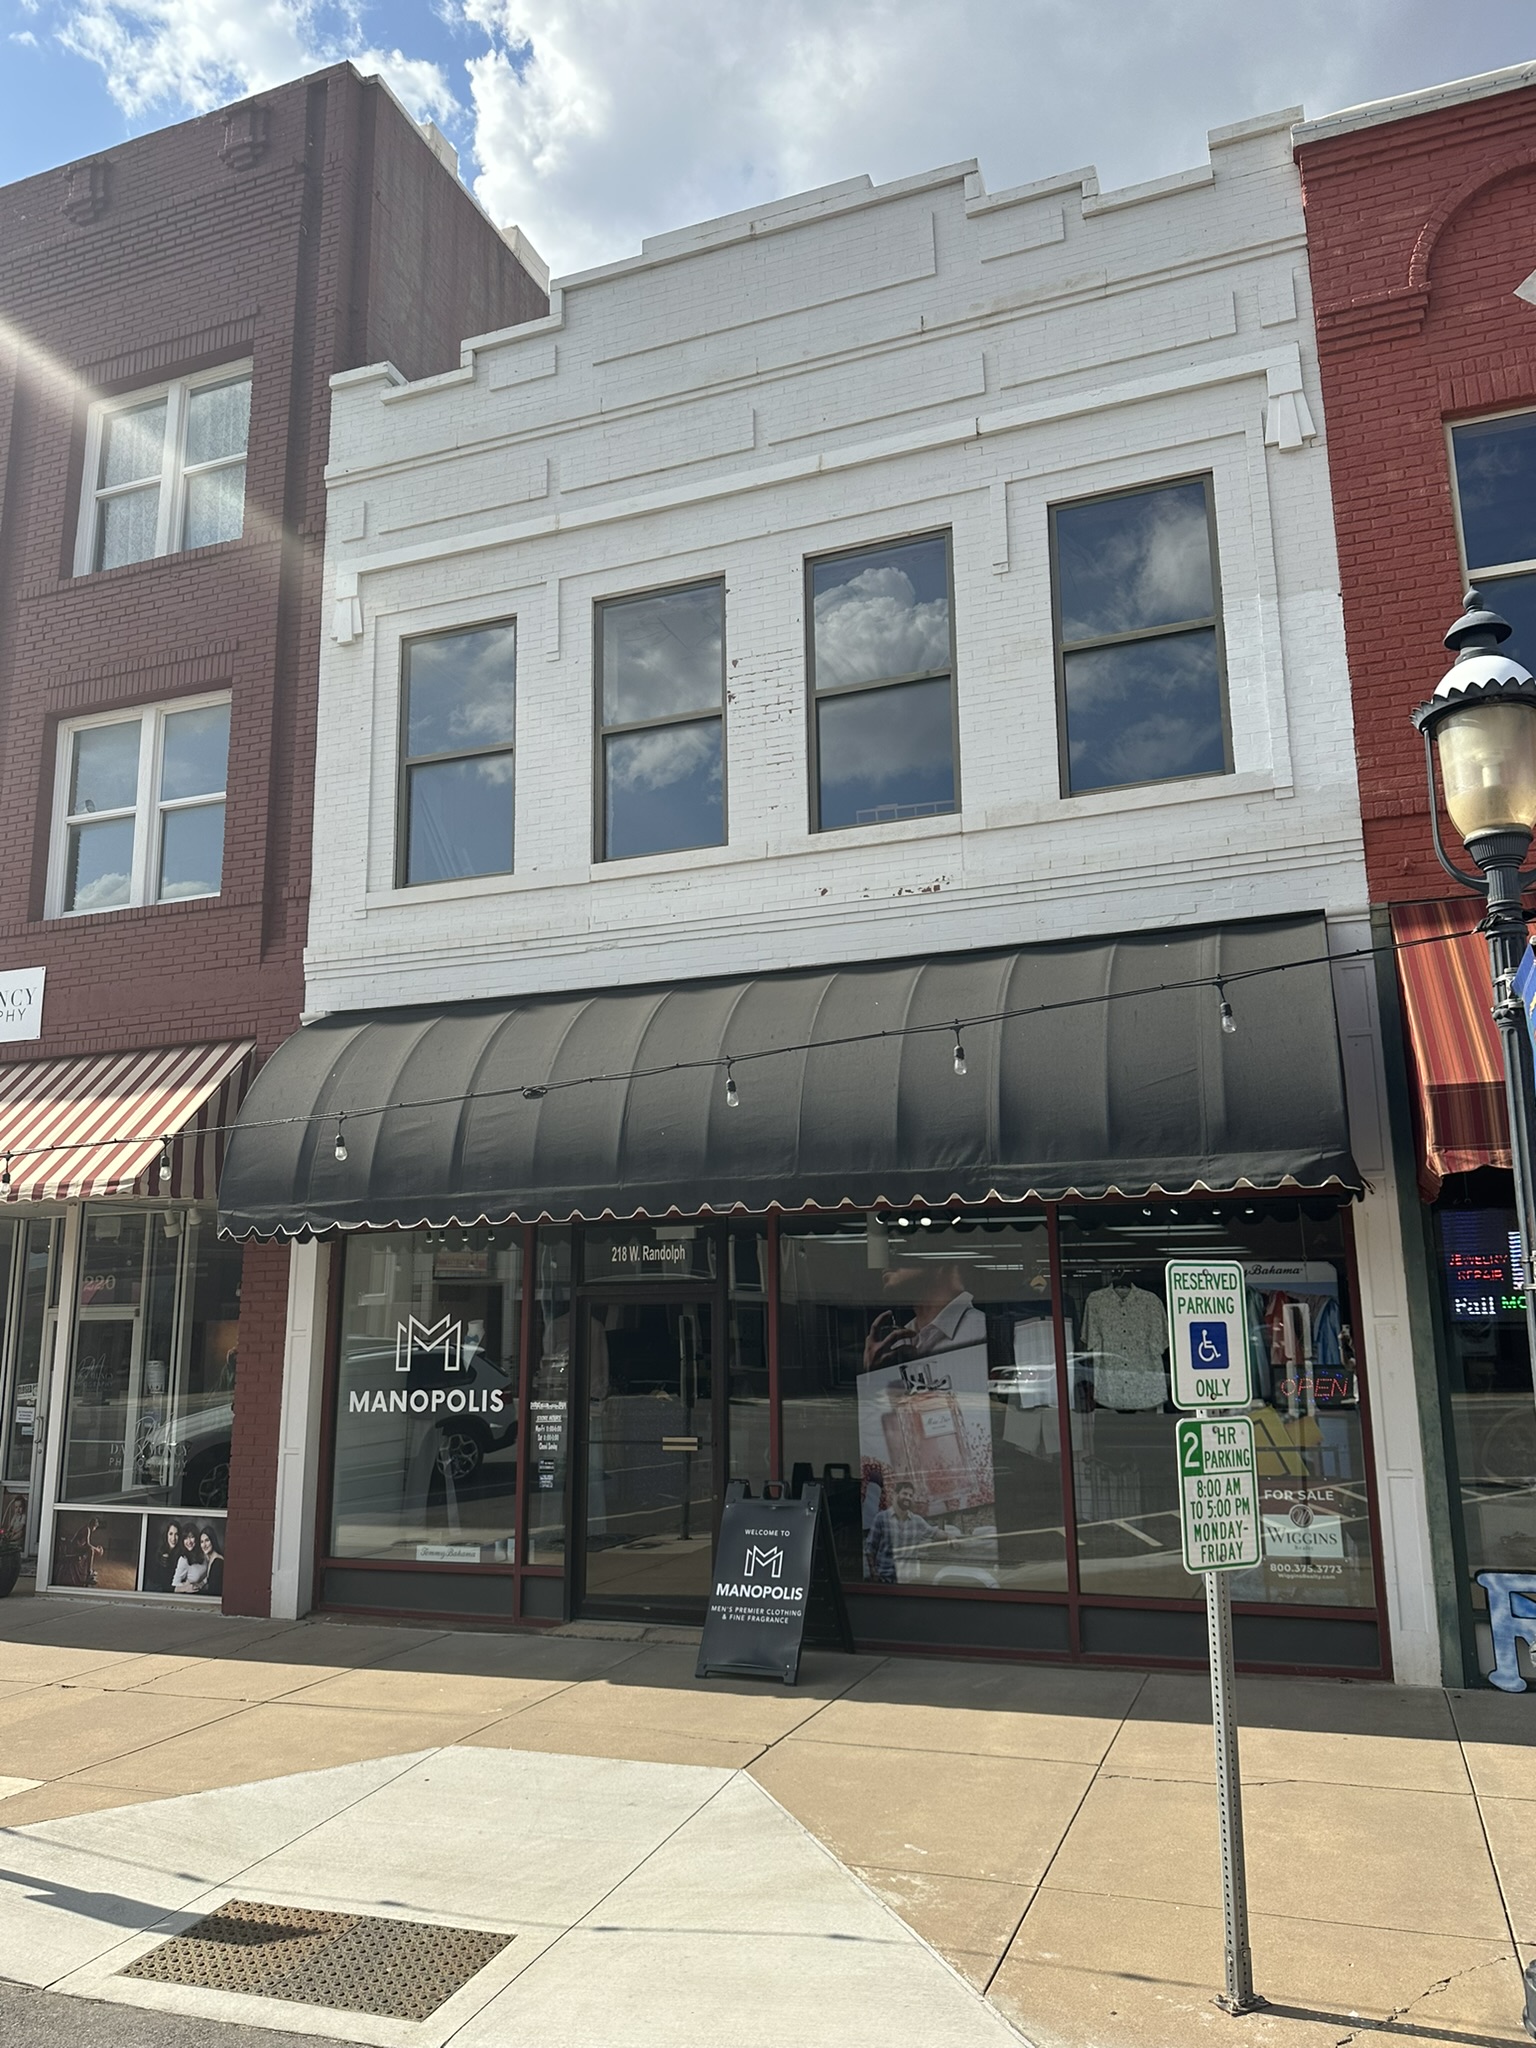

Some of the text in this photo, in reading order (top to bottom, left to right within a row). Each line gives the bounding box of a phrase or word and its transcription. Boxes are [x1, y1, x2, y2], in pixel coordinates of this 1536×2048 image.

[611, 1244, 686, 1264] 218 W. Randolph
[1249, 1264, 1300, 1276] Bahama
[83, 1275, 116, 1291] 220
[1173, 1272, 1238, 1291] RESERVED
[1177, 1296, 1235, 1315] PARKING
[1195, 1378, 1231, 1398] ONLY
[1280, 1377, 1349, 1398] OPEN
[349, 1389, 504, 1413] MANOPOLIS
[1217, 1426, 1237, 1445] HR
[1182, 1431, 1200, 1468] 2
[1204, 1448, 1250, 1469] PARKING
[1196, 1477, 1241, 1498] 8:00 AM
[1264, 1489, 1334, 1501] FOR SALE
[1190, 1497, 1250, 1519] TO 5:00 PM
[1194, 1520, 1249, 1542] MONDAY-
[1266, 1526, 1338, 1545] WIGGINS
[420, 1547, 476, 1559] Tommy Bahama
[1201, 1541, 1243, 1563] FRIDAY
[1269, 1563, 1343, 1574] 800.375.3773
[715, 1583, 804, 1601] MANOPOLIS
[711, 1605, 802, 1617] MEN'S PREMIER CLOTHING
[747, 1615, 789, 1624] FRAGRANCE
